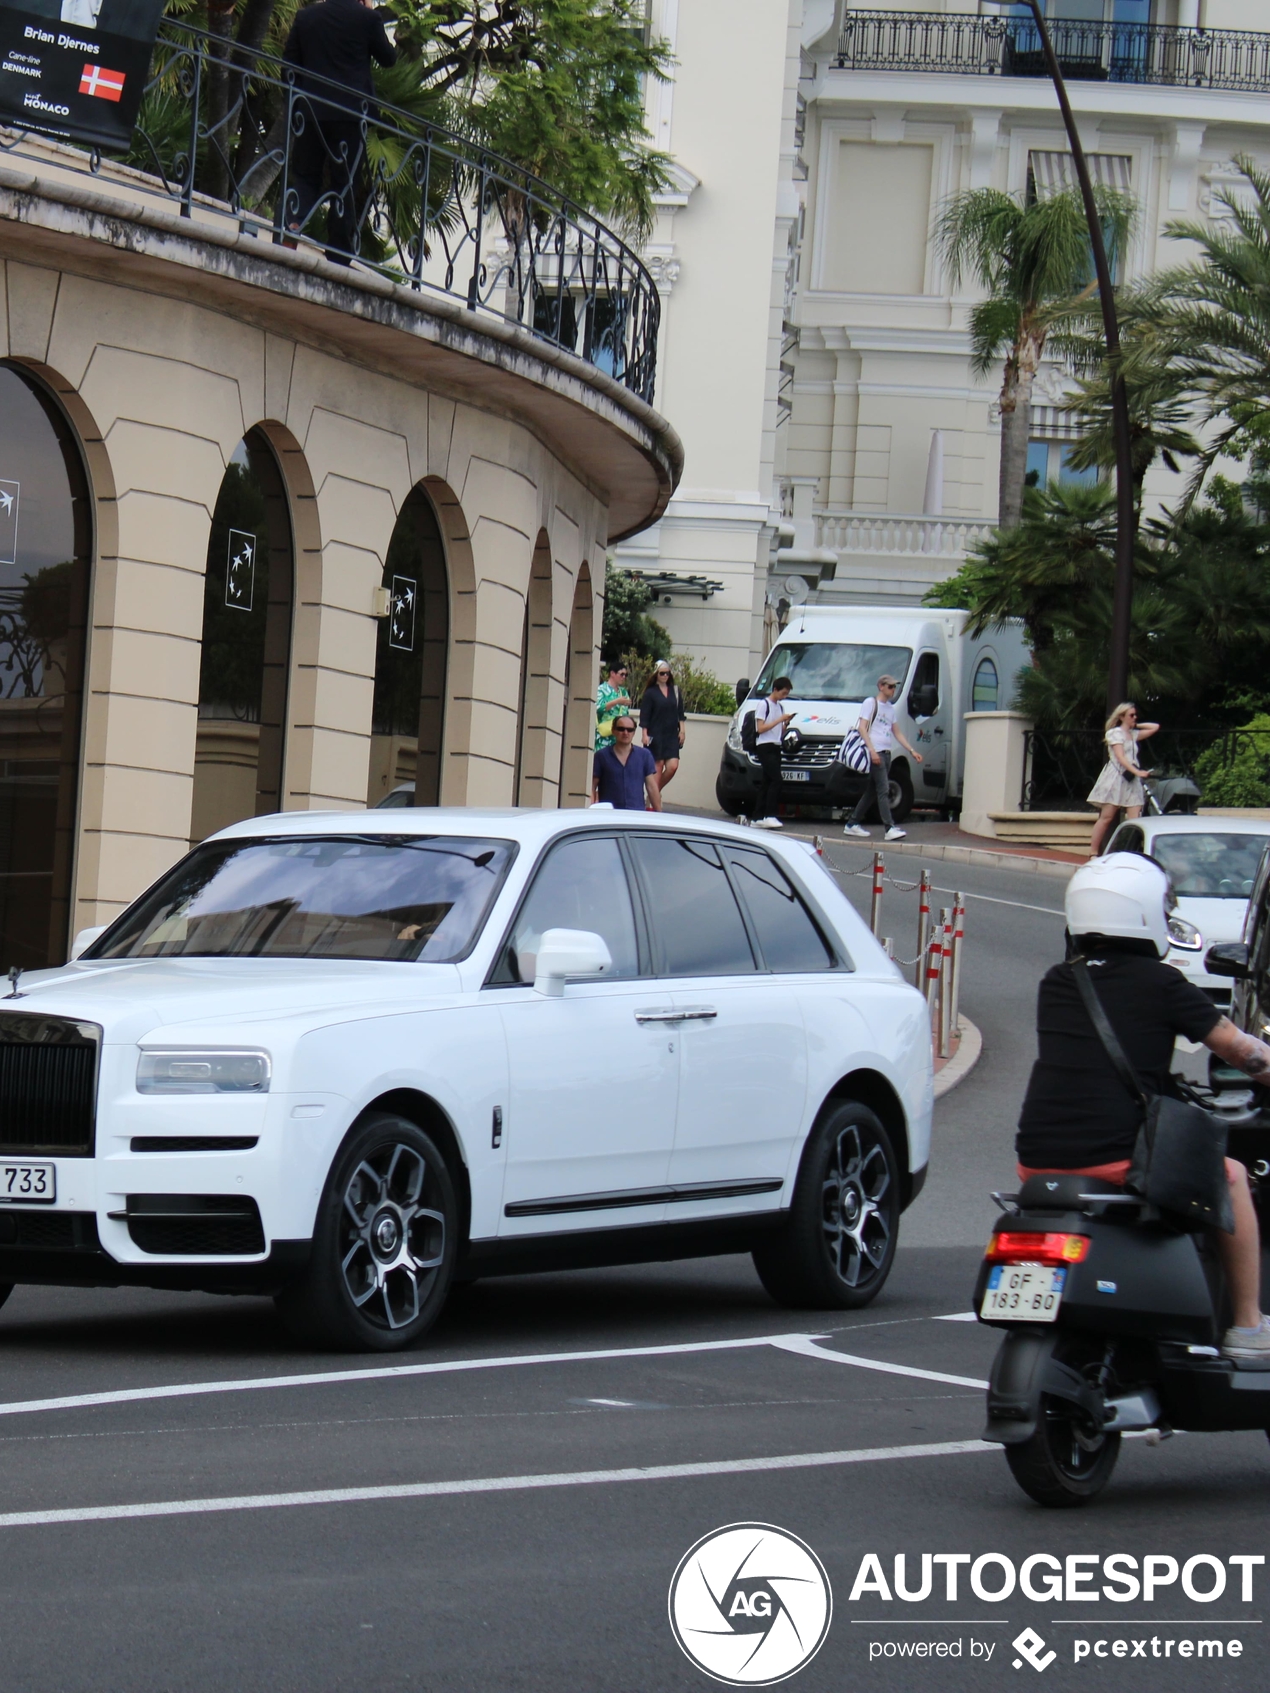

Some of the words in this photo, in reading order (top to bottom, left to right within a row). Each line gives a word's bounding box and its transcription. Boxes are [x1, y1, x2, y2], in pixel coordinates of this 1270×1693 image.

[23, 26, 55, 44] Brian
[57, 34, 100, 55] Djernes
[8, 50, 41, 65] Cane-line
[2, 61, 42, 78] DENMARK
[23, 97, 70, 116] MONACO
[816, 716, 841, 725] elis
[5, 1168, 46, 1193] 733
